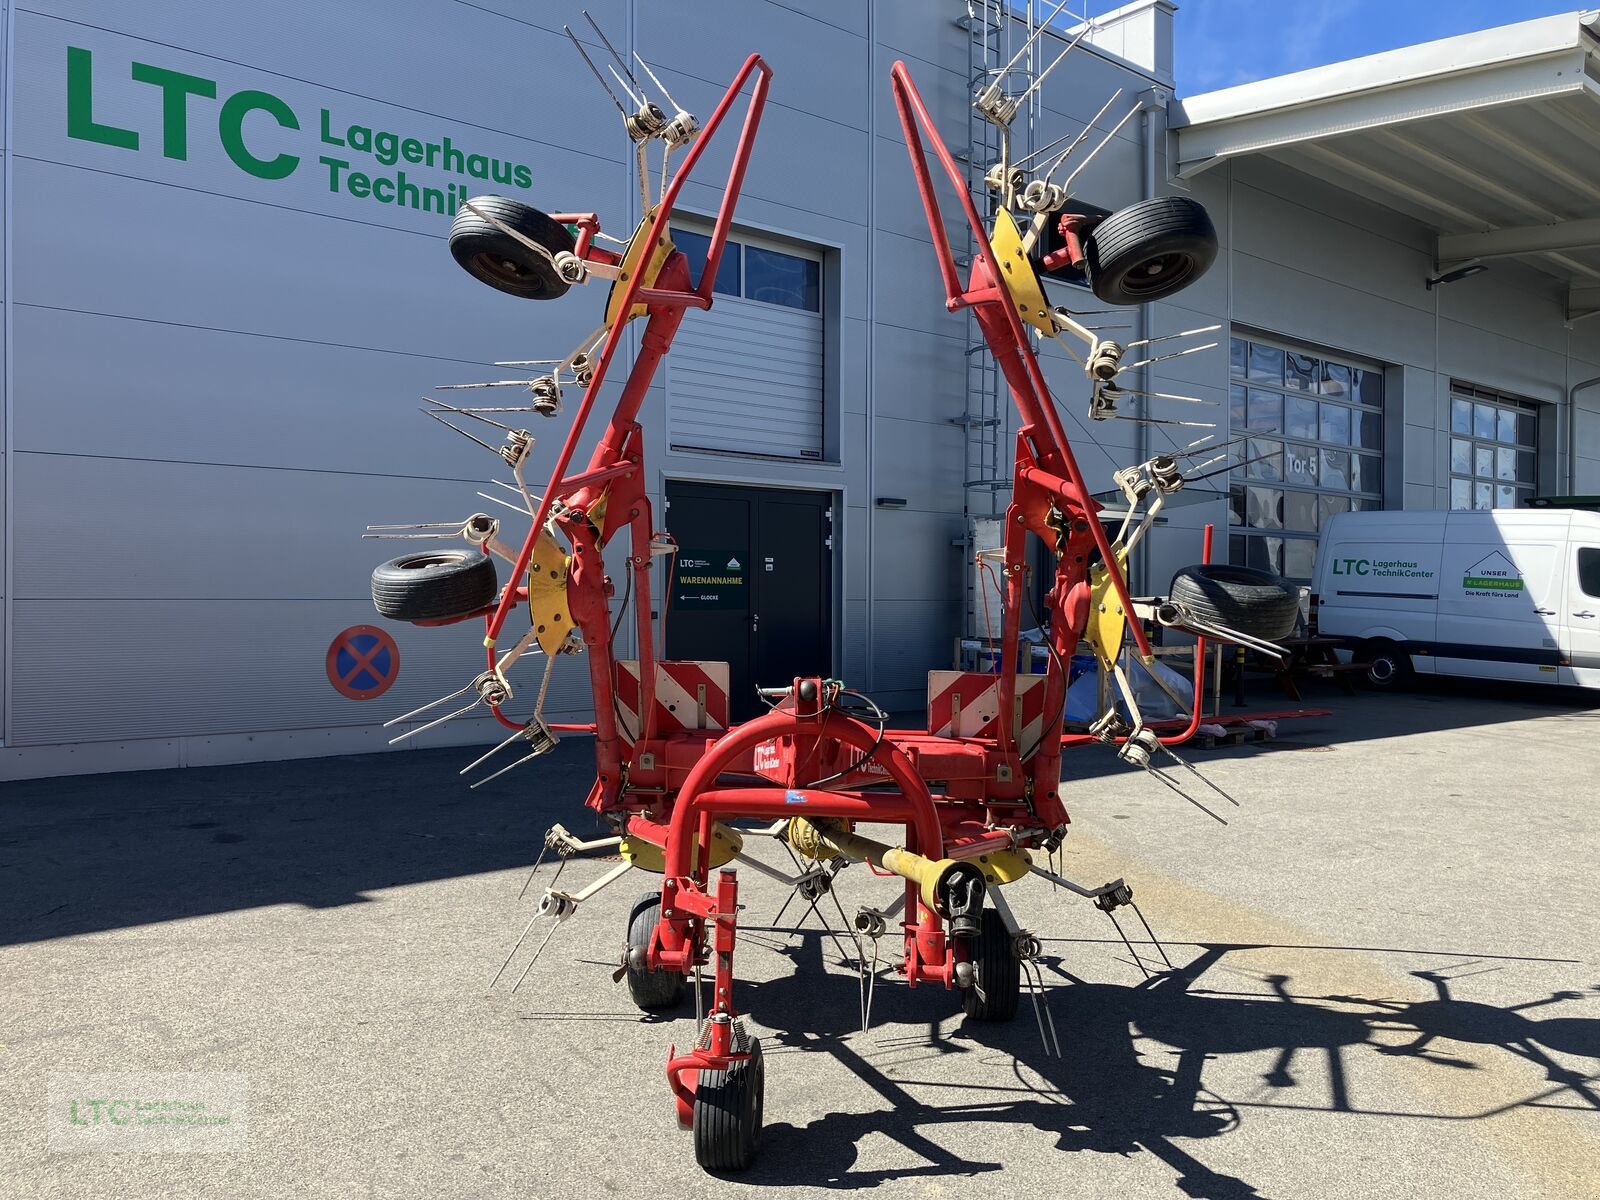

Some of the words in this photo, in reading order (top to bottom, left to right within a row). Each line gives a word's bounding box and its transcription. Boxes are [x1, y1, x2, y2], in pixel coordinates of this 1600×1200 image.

[67, 46, 301, 180] LTC
[320, 108, 533, 189] Lagerhaus
[1287, 454, 1306, 473] Tor
[1309, 456, 1317, 476] 5
[1332, 559, 1370, 576] LTC
[1373, 560, 1418, 569] Lagerhaus
[1372, 569, 1434, 578] TechnikCenter
[1473, 580, 1521, 588] LAGERHAUS
